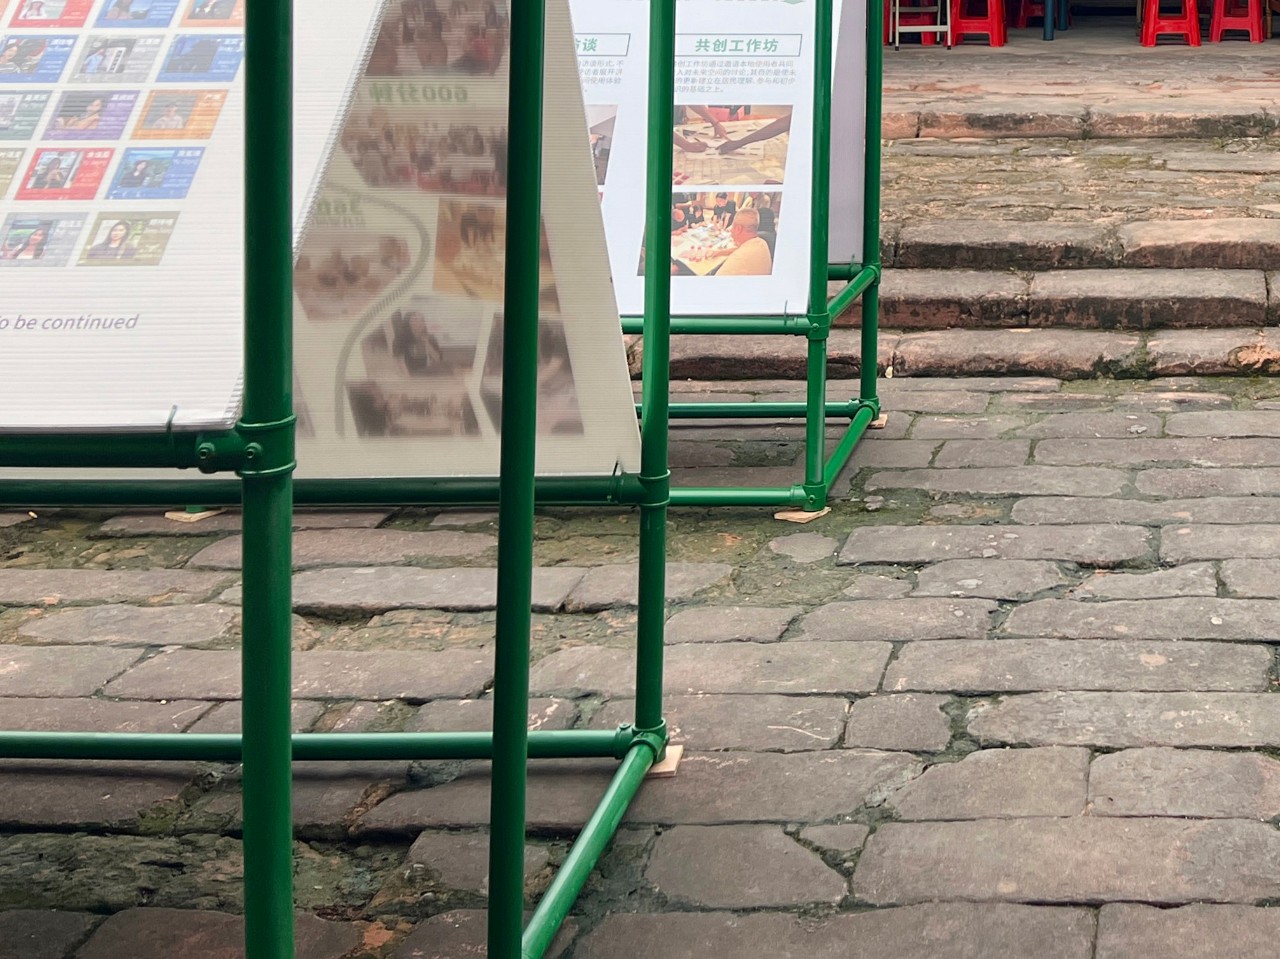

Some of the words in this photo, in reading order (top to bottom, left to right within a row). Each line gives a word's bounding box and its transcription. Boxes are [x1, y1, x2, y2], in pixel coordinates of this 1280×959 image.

[694, 38, 779, 53] 共创工作坊
[14, 314, 37, 330] be
[41, 313, 140, 330] continued
